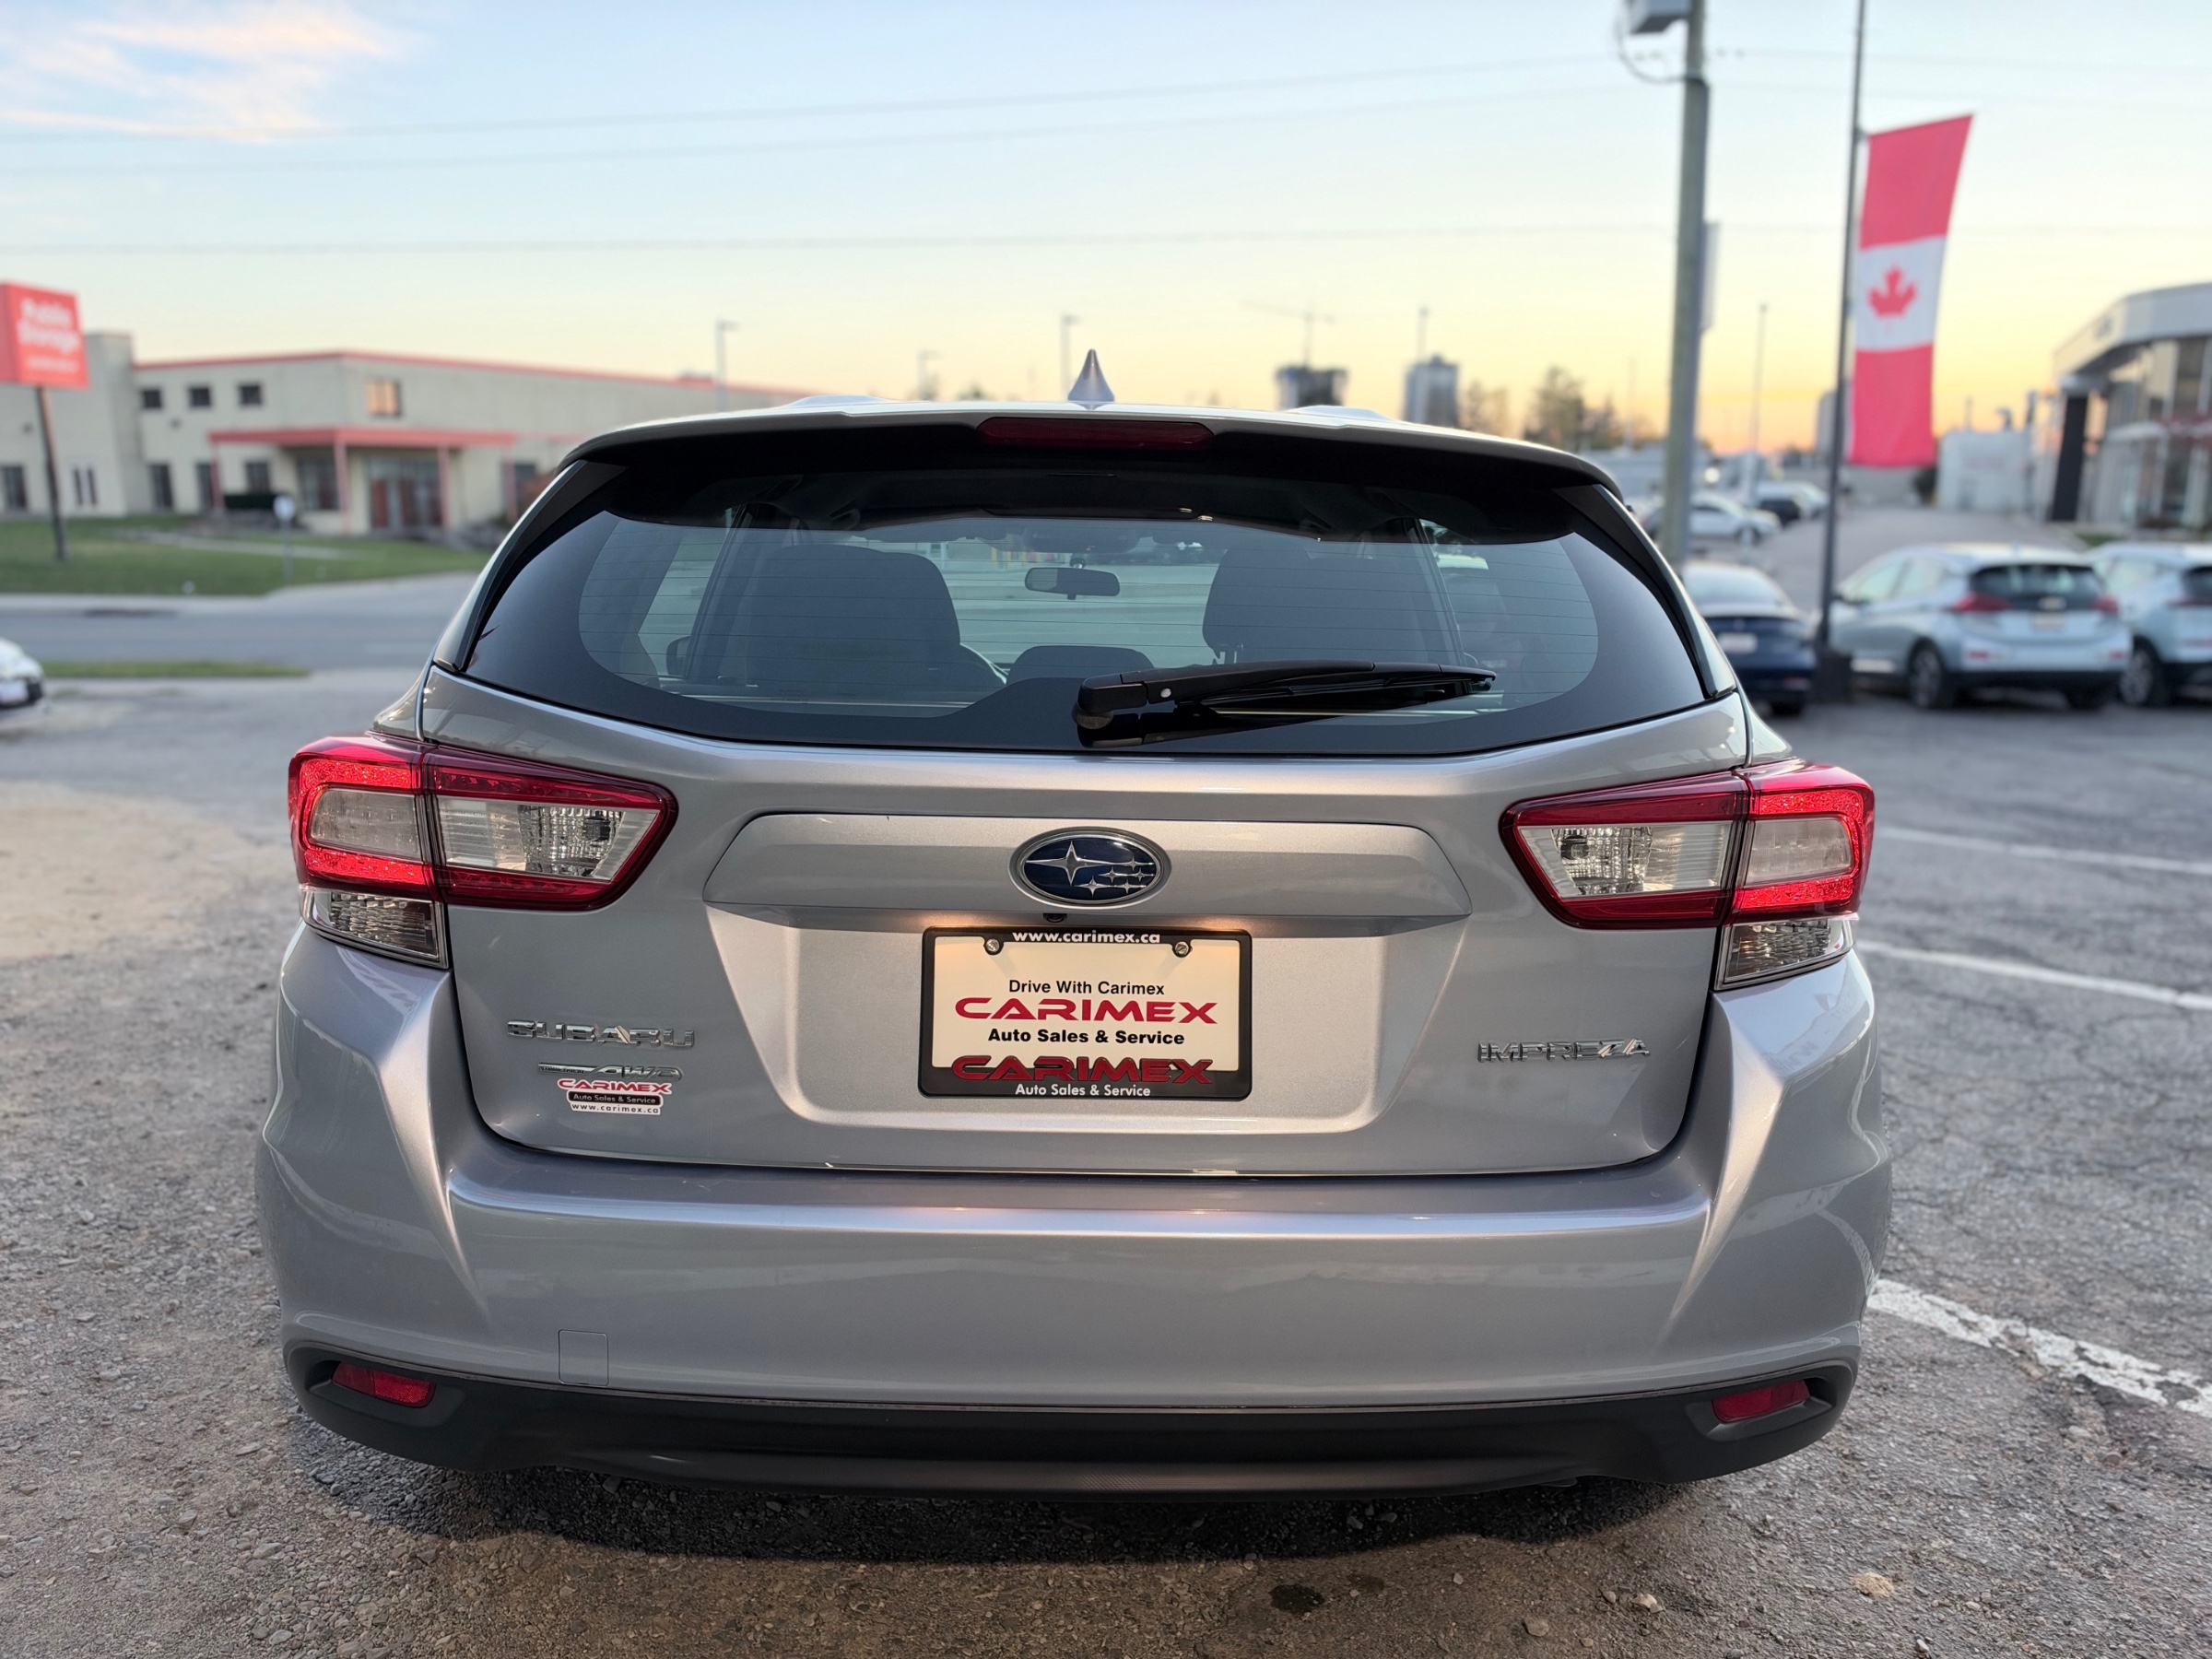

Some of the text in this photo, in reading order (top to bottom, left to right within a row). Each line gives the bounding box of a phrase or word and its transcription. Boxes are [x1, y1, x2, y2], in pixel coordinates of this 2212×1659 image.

[1012, 929, 1160, 944] www.carimex.ca
[1009, 980, 1165, 995] Drive With Carimex
[955, 997, 1218, 1024] CARIMEX
[507, 1019, 695, 1048] SUBARU
[988, 1028, 1185, 1045] Auto Sales & Service
[1477, 1038, 1650, 1063] IMPREZA
[584, 1065, 684, 1082] AWD
[951, 1055, 1214, 1085] CARIMEX
[559, 1079, 671, 1093] CARIMEX
[1015, 1083, 1151, 1097] Auto Sales & Service
[573, 1093, 593, 1101] Auto
[594, 1094, 616, 1102] Sales
[627, 1096, 656, 1104] Service
[571, 1104, 659, 1113] www.carimex.ca
